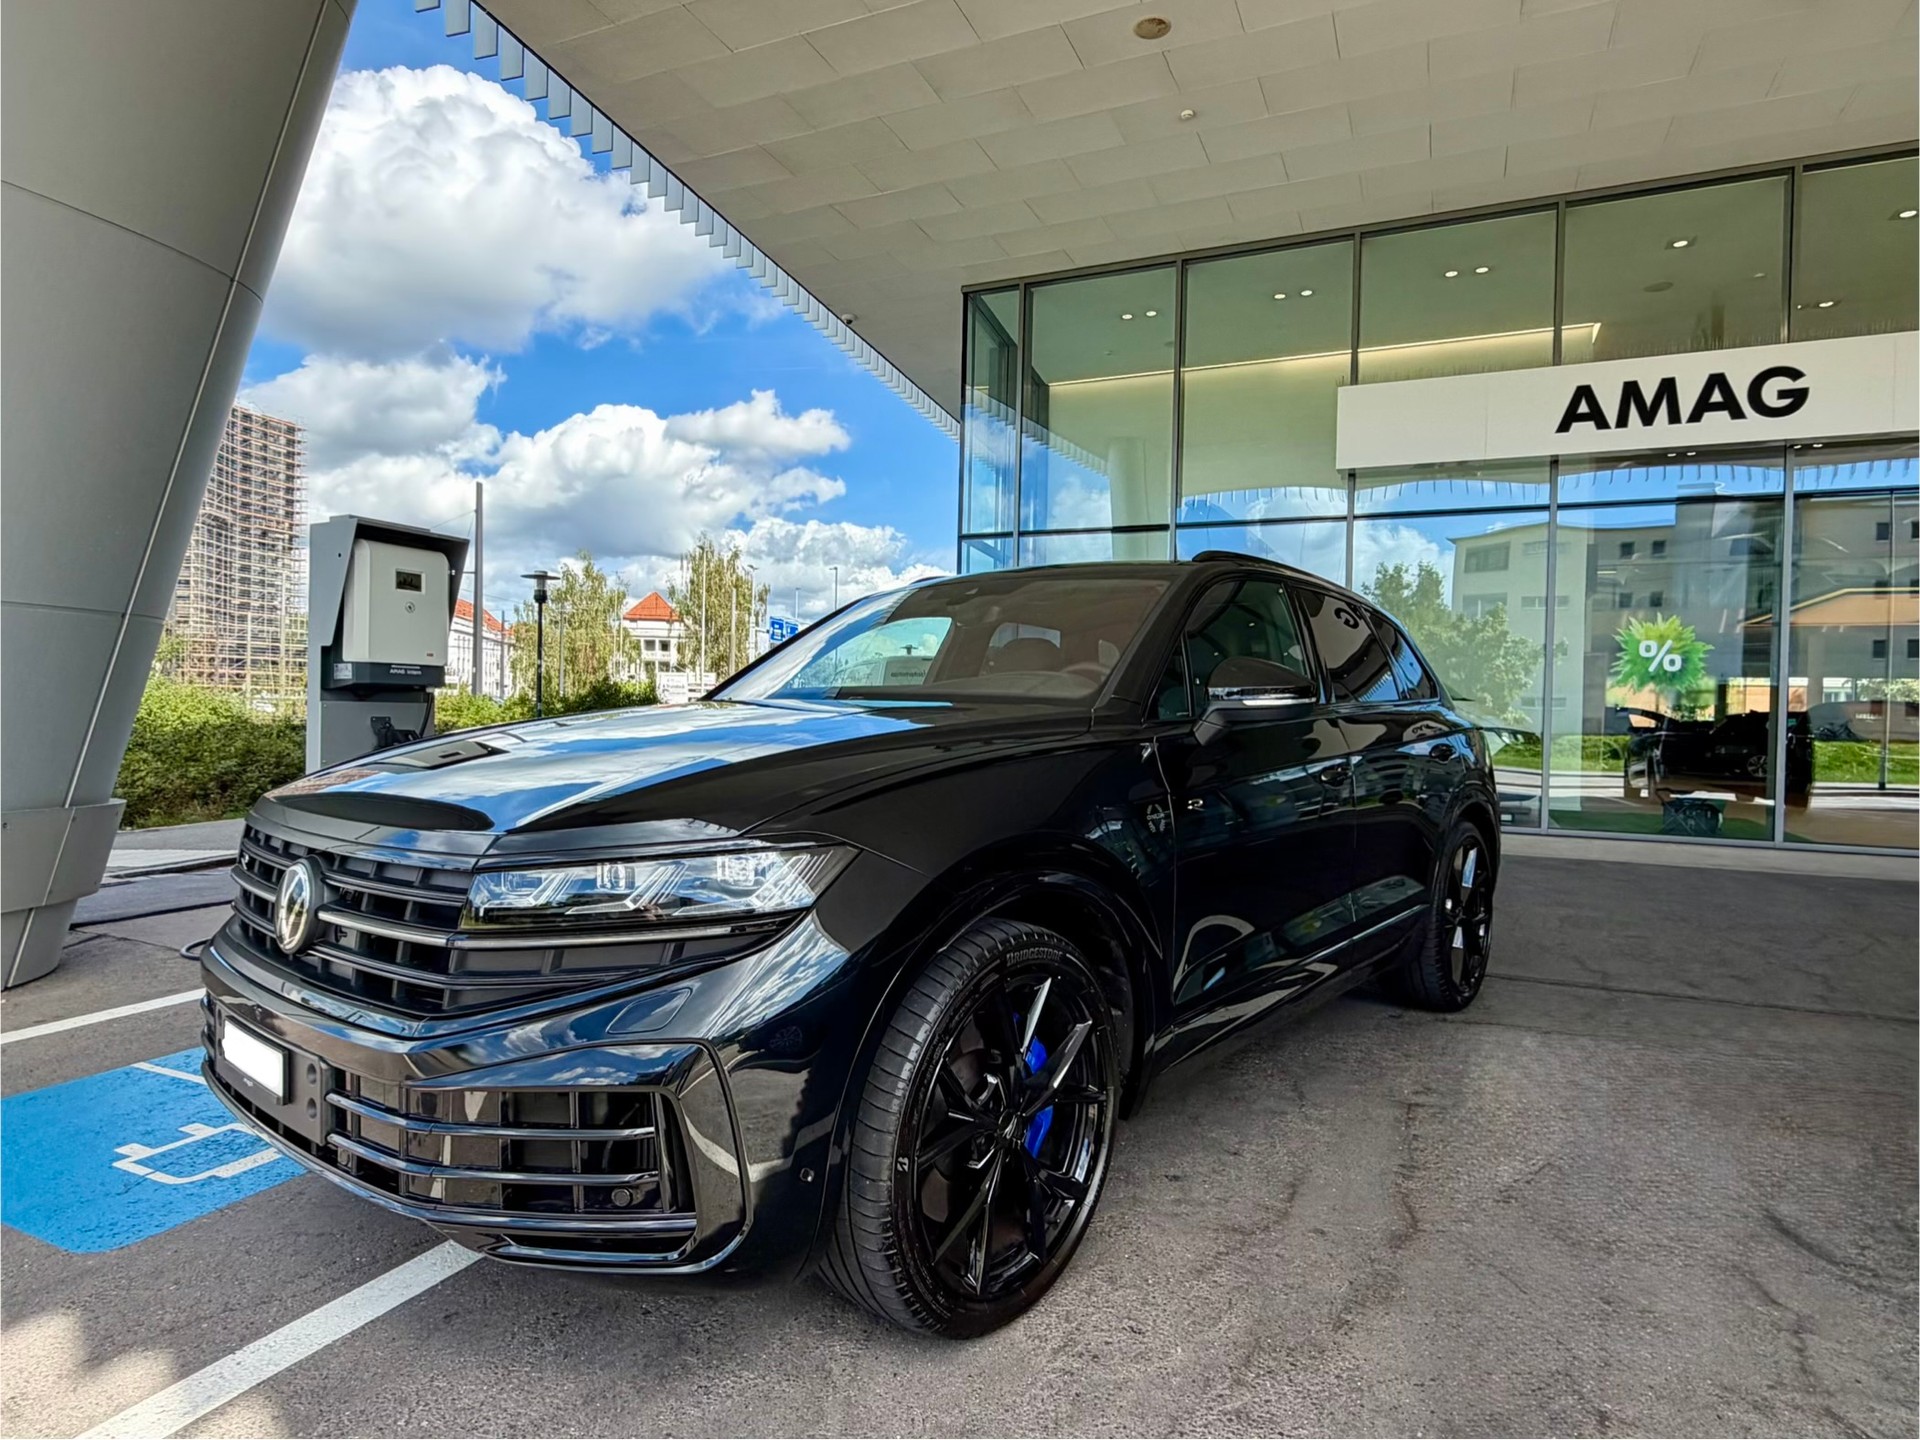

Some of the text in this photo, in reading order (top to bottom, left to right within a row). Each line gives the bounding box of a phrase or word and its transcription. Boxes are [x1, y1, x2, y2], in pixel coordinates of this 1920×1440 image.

[1555, 366, 1810, 433] AMAG
[1639, 640, 1682, 672] %
[1006, 947, 1063, 967] BRIDGESTONE
